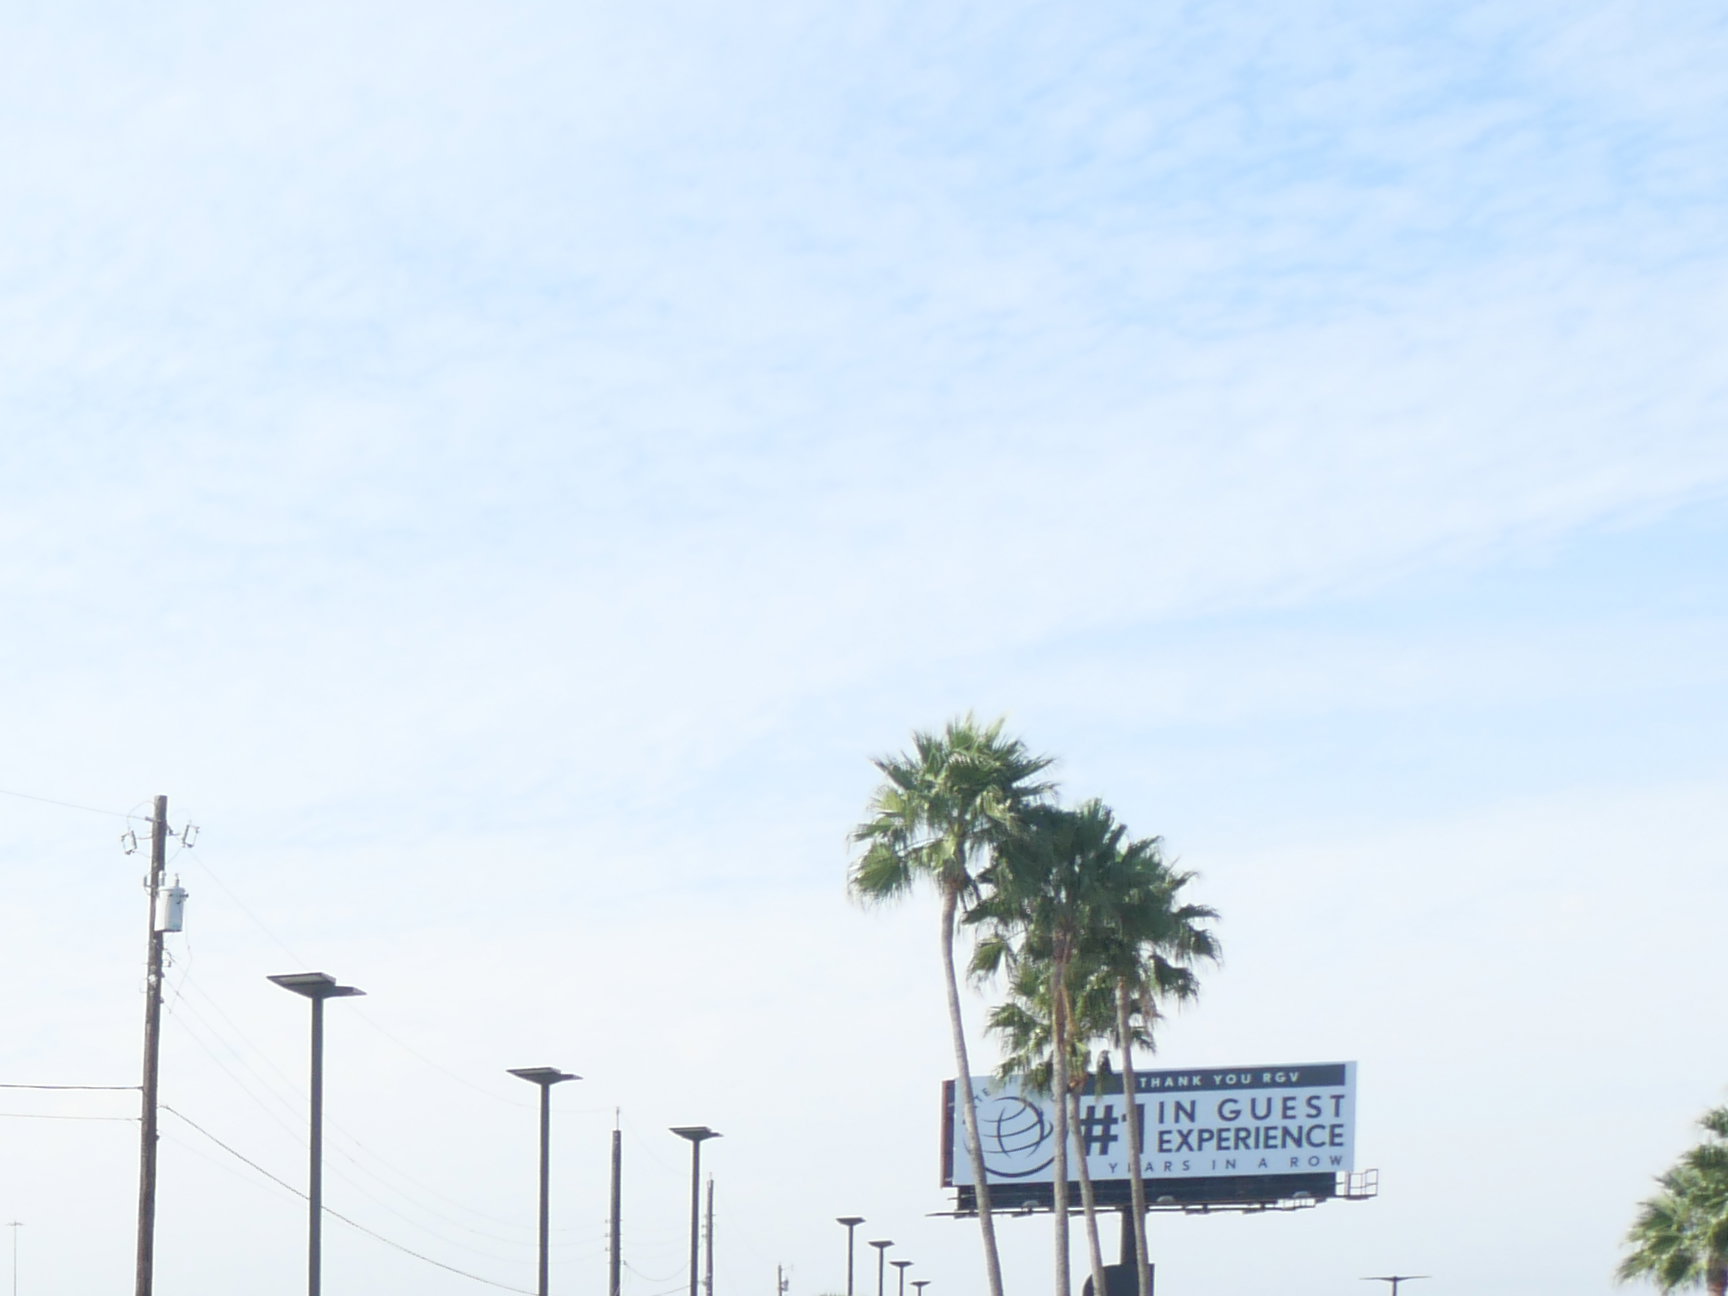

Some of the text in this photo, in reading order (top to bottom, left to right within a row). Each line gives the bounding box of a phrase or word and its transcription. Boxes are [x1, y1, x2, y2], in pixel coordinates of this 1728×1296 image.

[1139, 1071, 1300, 1089] THANK YOU RGV
[1157, 1094, 1346, 1125] IN GUEST
[1157, 1123, 1345, 1153] EXPERIENCE
[1108, 1155, 1344, 1174] YARS IN A ROW
